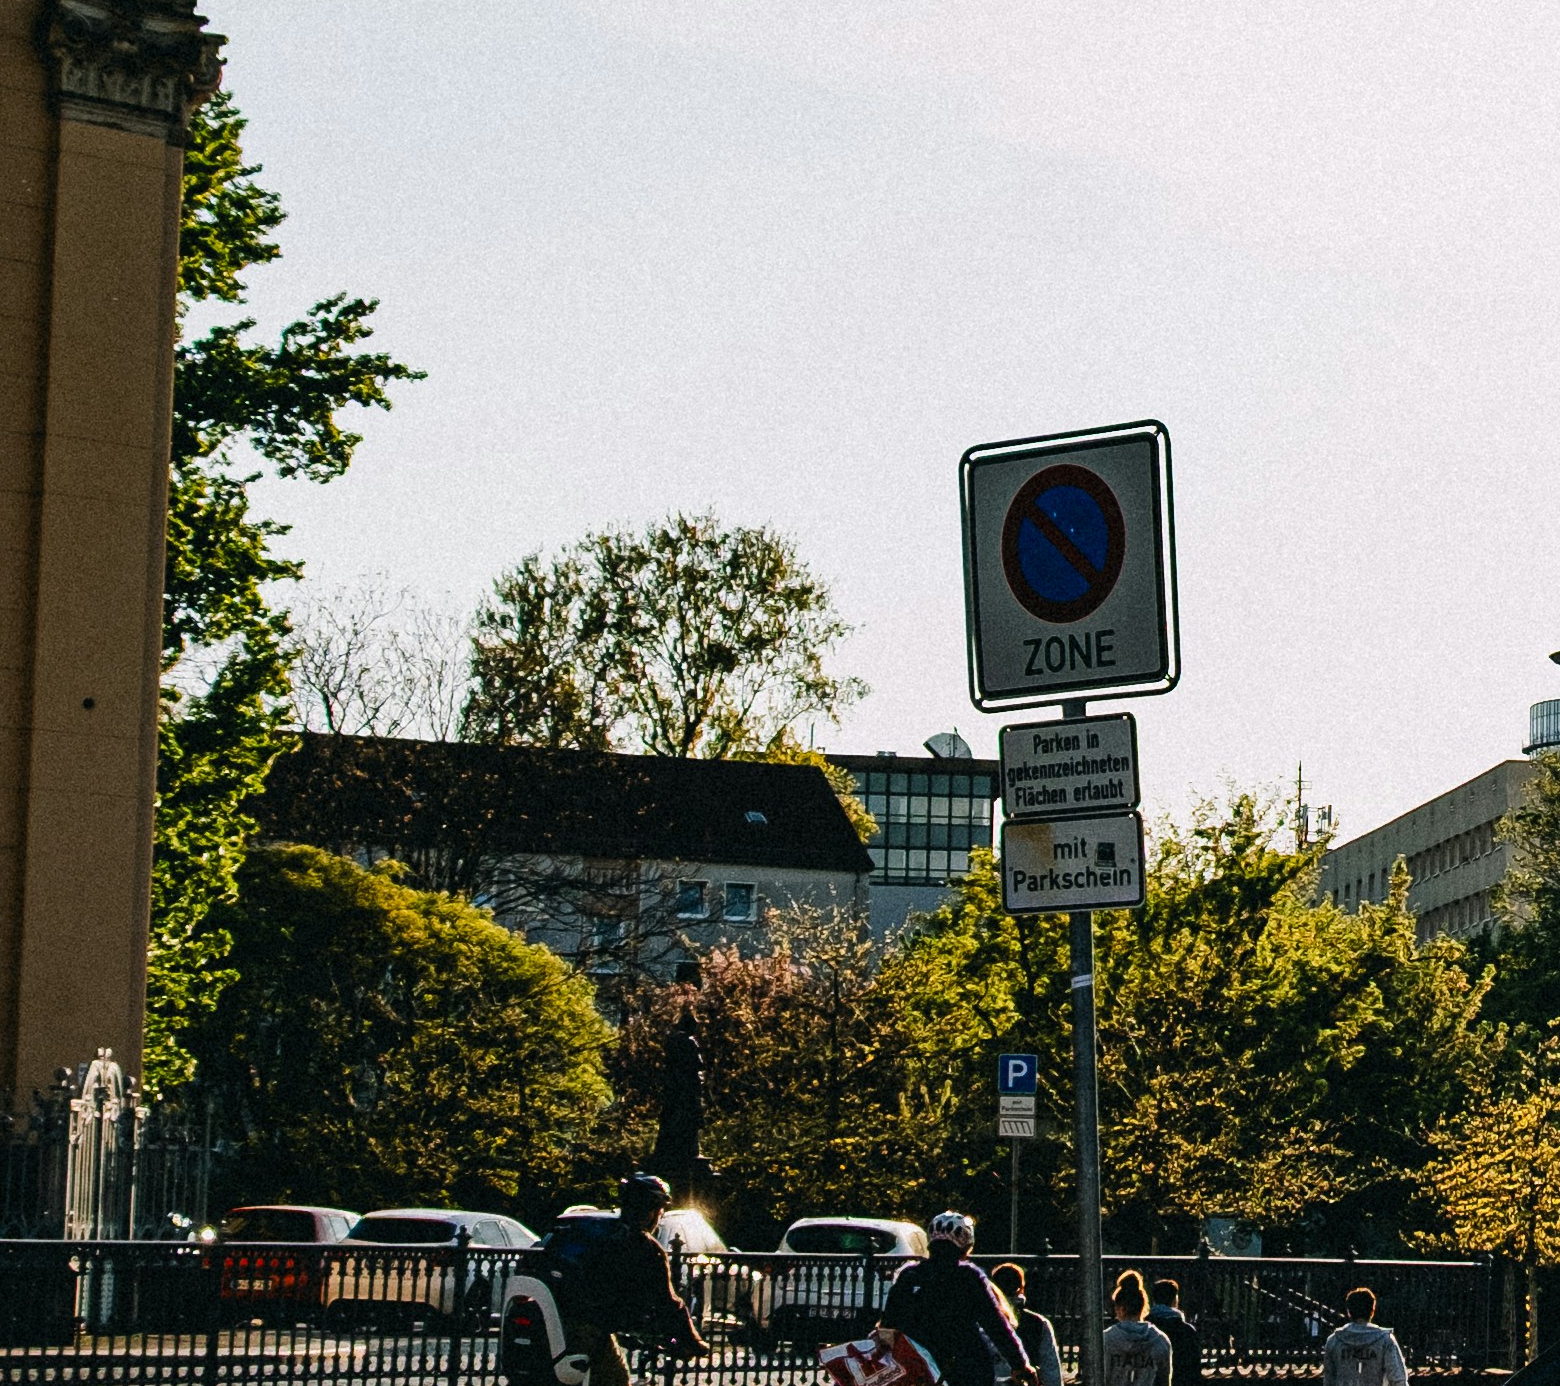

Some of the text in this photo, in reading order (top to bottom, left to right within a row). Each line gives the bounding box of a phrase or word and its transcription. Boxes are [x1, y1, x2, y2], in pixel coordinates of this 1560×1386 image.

[1024, 629, 1116, 676] ZONE
[1033, 729, 1100, 754] Parken in
[1007, 754, 1130, 787] gekennzeichneten
[1015, 778, 1125, 807] Flächen erlaubt
[1053, 836, 1088, 860] mit
[1013, 866, 1131, 893] Parkschein
[1008, 1059, 1028, 1088] P
